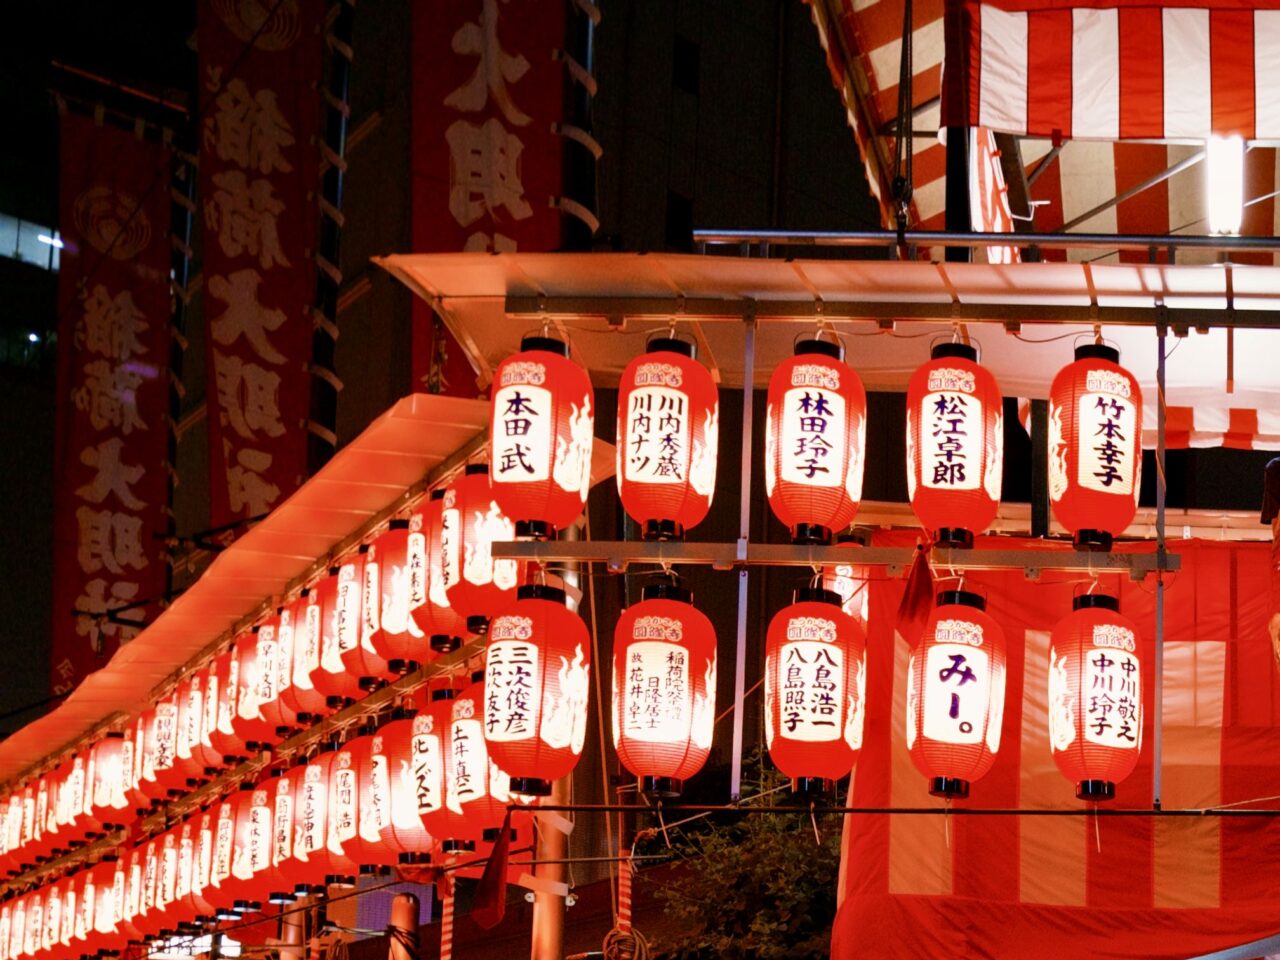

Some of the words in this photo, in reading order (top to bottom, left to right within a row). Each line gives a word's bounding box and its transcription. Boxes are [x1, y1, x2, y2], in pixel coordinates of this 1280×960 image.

[499, 390, 539, 474] 本田武
[630, 394, 652, 473] 川内ナツ
[653, 395, 682, 480] 川内秀蔵
[794, 391, 834, 479] 林田玲子
[931, 394, 969, 485] 松江卓郎
[1092, 396, 1126, 487] 竹本幸子
[486, 647, 504, 734] 三次友子
[505, 646, 533, 734] 三次俊彦
[628, 652, 644, 730] 故花井卓二
[645, 676, 663, 729] 日隆居士
[783, 647, 808, 733] 八島照子
[810, 648, 839, 728] 八島浩一
[939, 654, 977, 734] みー。
[1088, 652, 1116, 736] 中川玲子
[1117, 656, 1137, 742] 中川敬之
